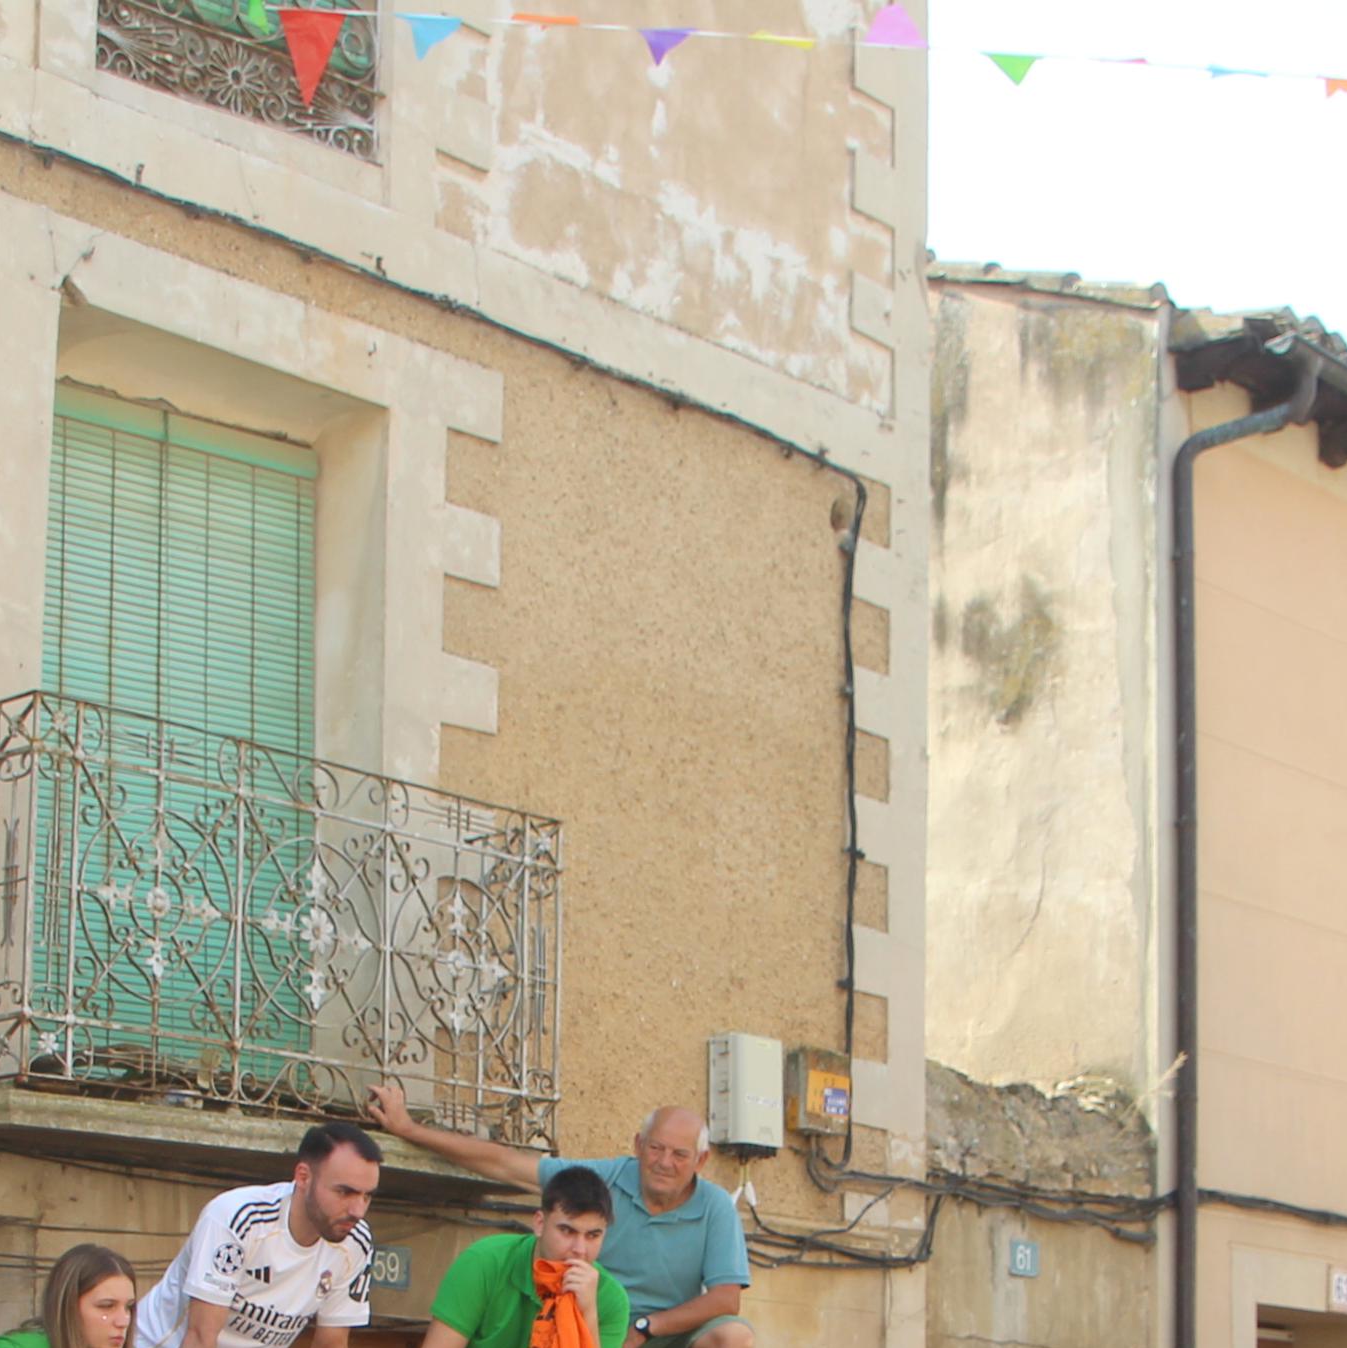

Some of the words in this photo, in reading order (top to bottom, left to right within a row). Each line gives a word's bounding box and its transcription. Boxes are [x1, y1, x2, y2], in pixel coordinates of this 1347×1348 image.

[374, 1251, 400, 1283] 59
[1016, 1245, 1031, 1270] 61
[228, 1315, 254, 1335] FLY
